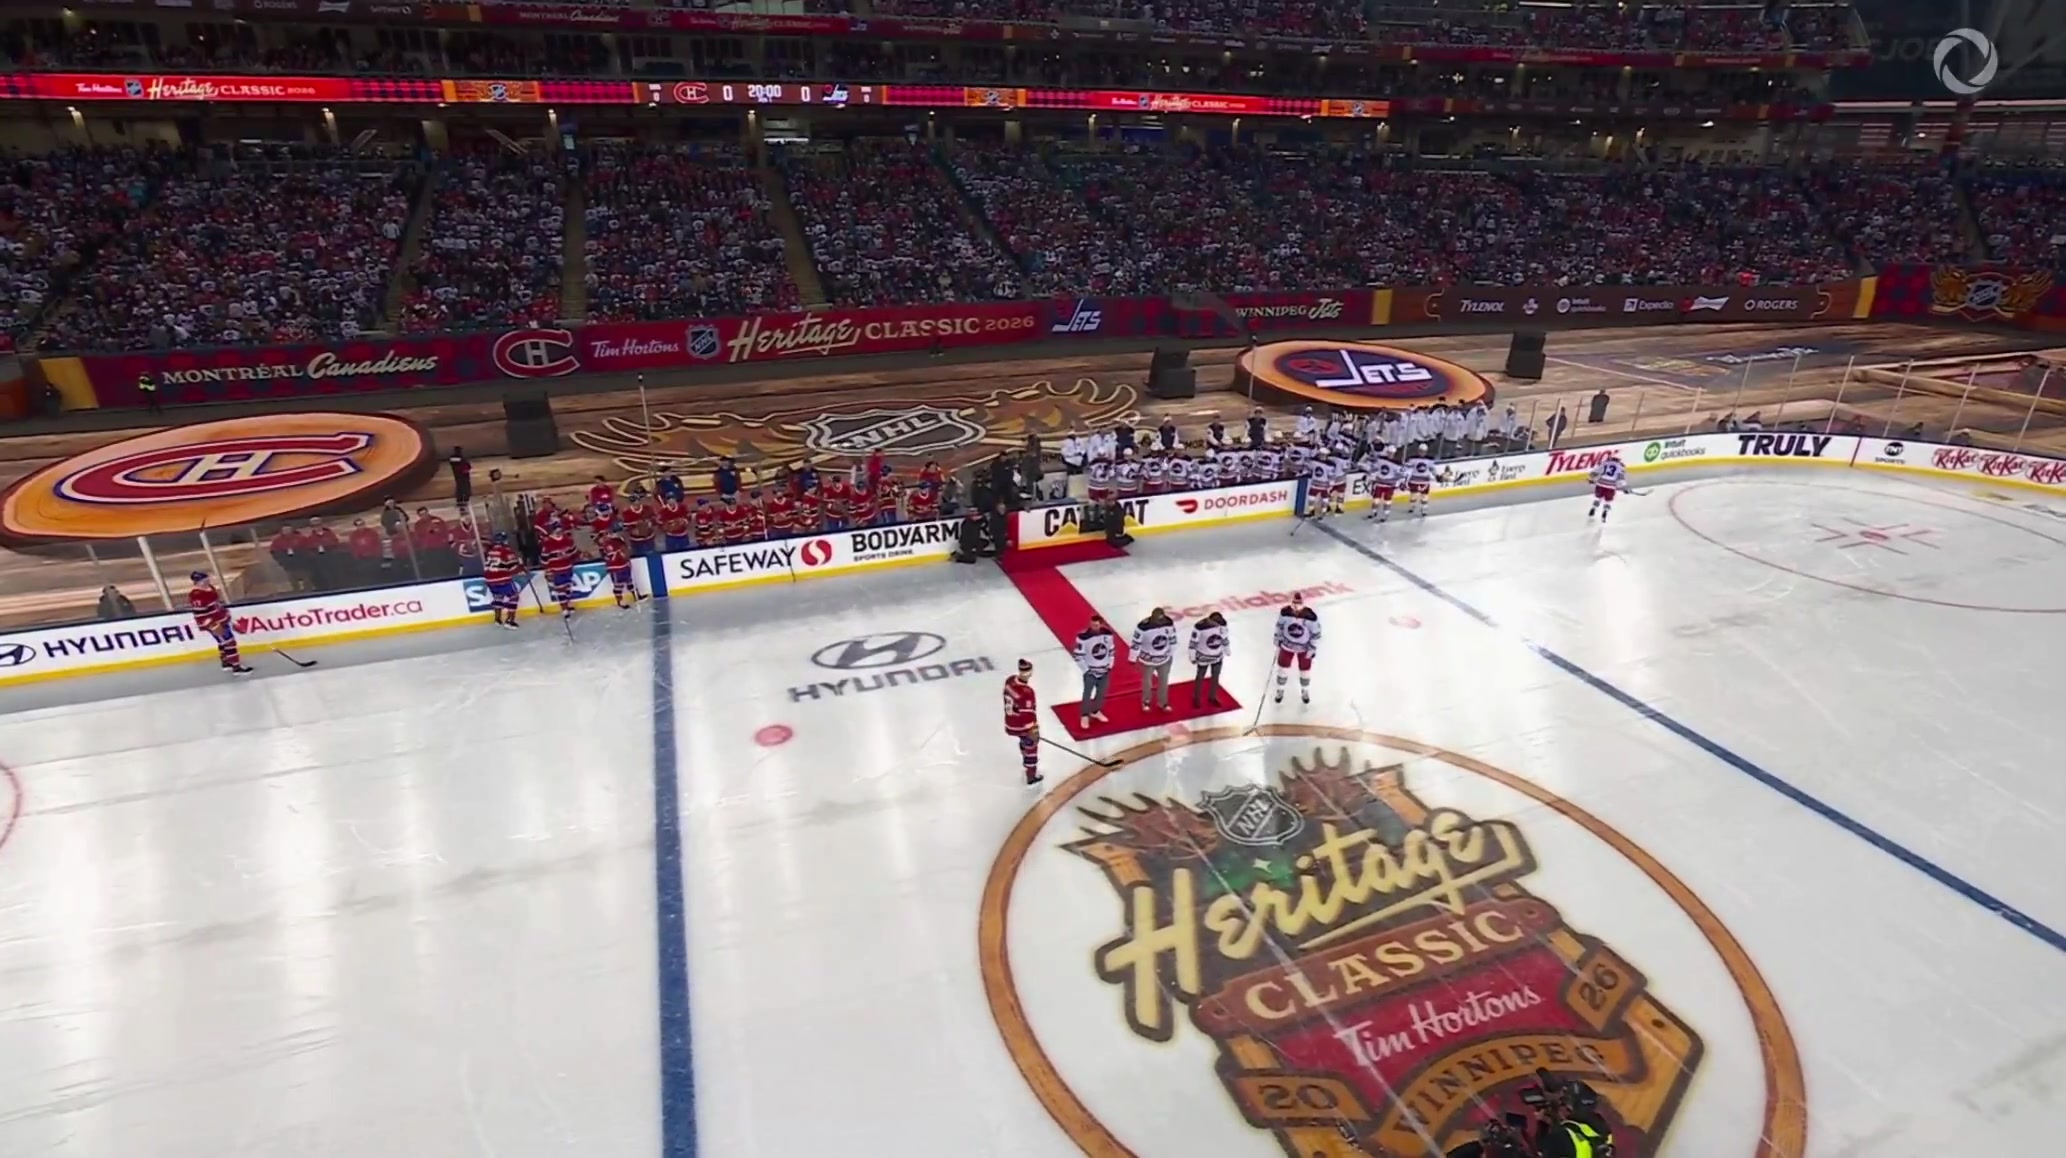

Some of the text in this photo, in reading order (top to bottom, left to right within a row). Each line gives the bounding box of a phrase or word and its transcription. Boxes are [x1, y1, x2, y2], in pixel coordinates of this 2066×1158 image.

[147, 78, 219, 100] Heritage
[219, 85, 286, 96] CLASSIC
[722, 85, 733, 101] 0
[747, 84, 782, 98] 20:00
[800, 86, 811, 102] 0
[1235, 304, 1307, 318] WINNIPEG
[1460, 299, 1505, 313] TYLENOL
[1638, 299, 1675, 312] Expedia
[1756, 299, 1799, 311] ROGERS
[590, 337, 680, 359] Tim Hortons
[727, 312, 1035, 363] Heritage CLASSIC 2026
[161, 350, 439, 385] MONTRÉAL Canadiens
[850, 416, 938, 449] NHL
[1737, 435, 1833, 457] TRULY
[1545, 449, 1619, 476] TYLENO
[1603, 465, 1617, 477] 13
[1203, 490, 1288, 511] DOORDASH
[680, 546, 797, 580] SAFEWAY
[853, 548, 913, 562] SPORTS DRINK
[250, 600, 423, 633] AutoTrader.ca
[42, 624, 195, 658] HYUNDAI
[787, 656, 997, 703] HYUNDAI
[1236, 799, 1270, 836] NHL
[1104, 811, 1490, 1030] Heritage
[1245, 909, 1525, 1020] CLASSIC
[1579, 963, 1621, 1012] 26
[1332, 982, 1541, 1067] Tim Hortons
[1258, 1084, 1338, 1110] 20
[1393, 1042, 1606, 1133] WINNIPEG
